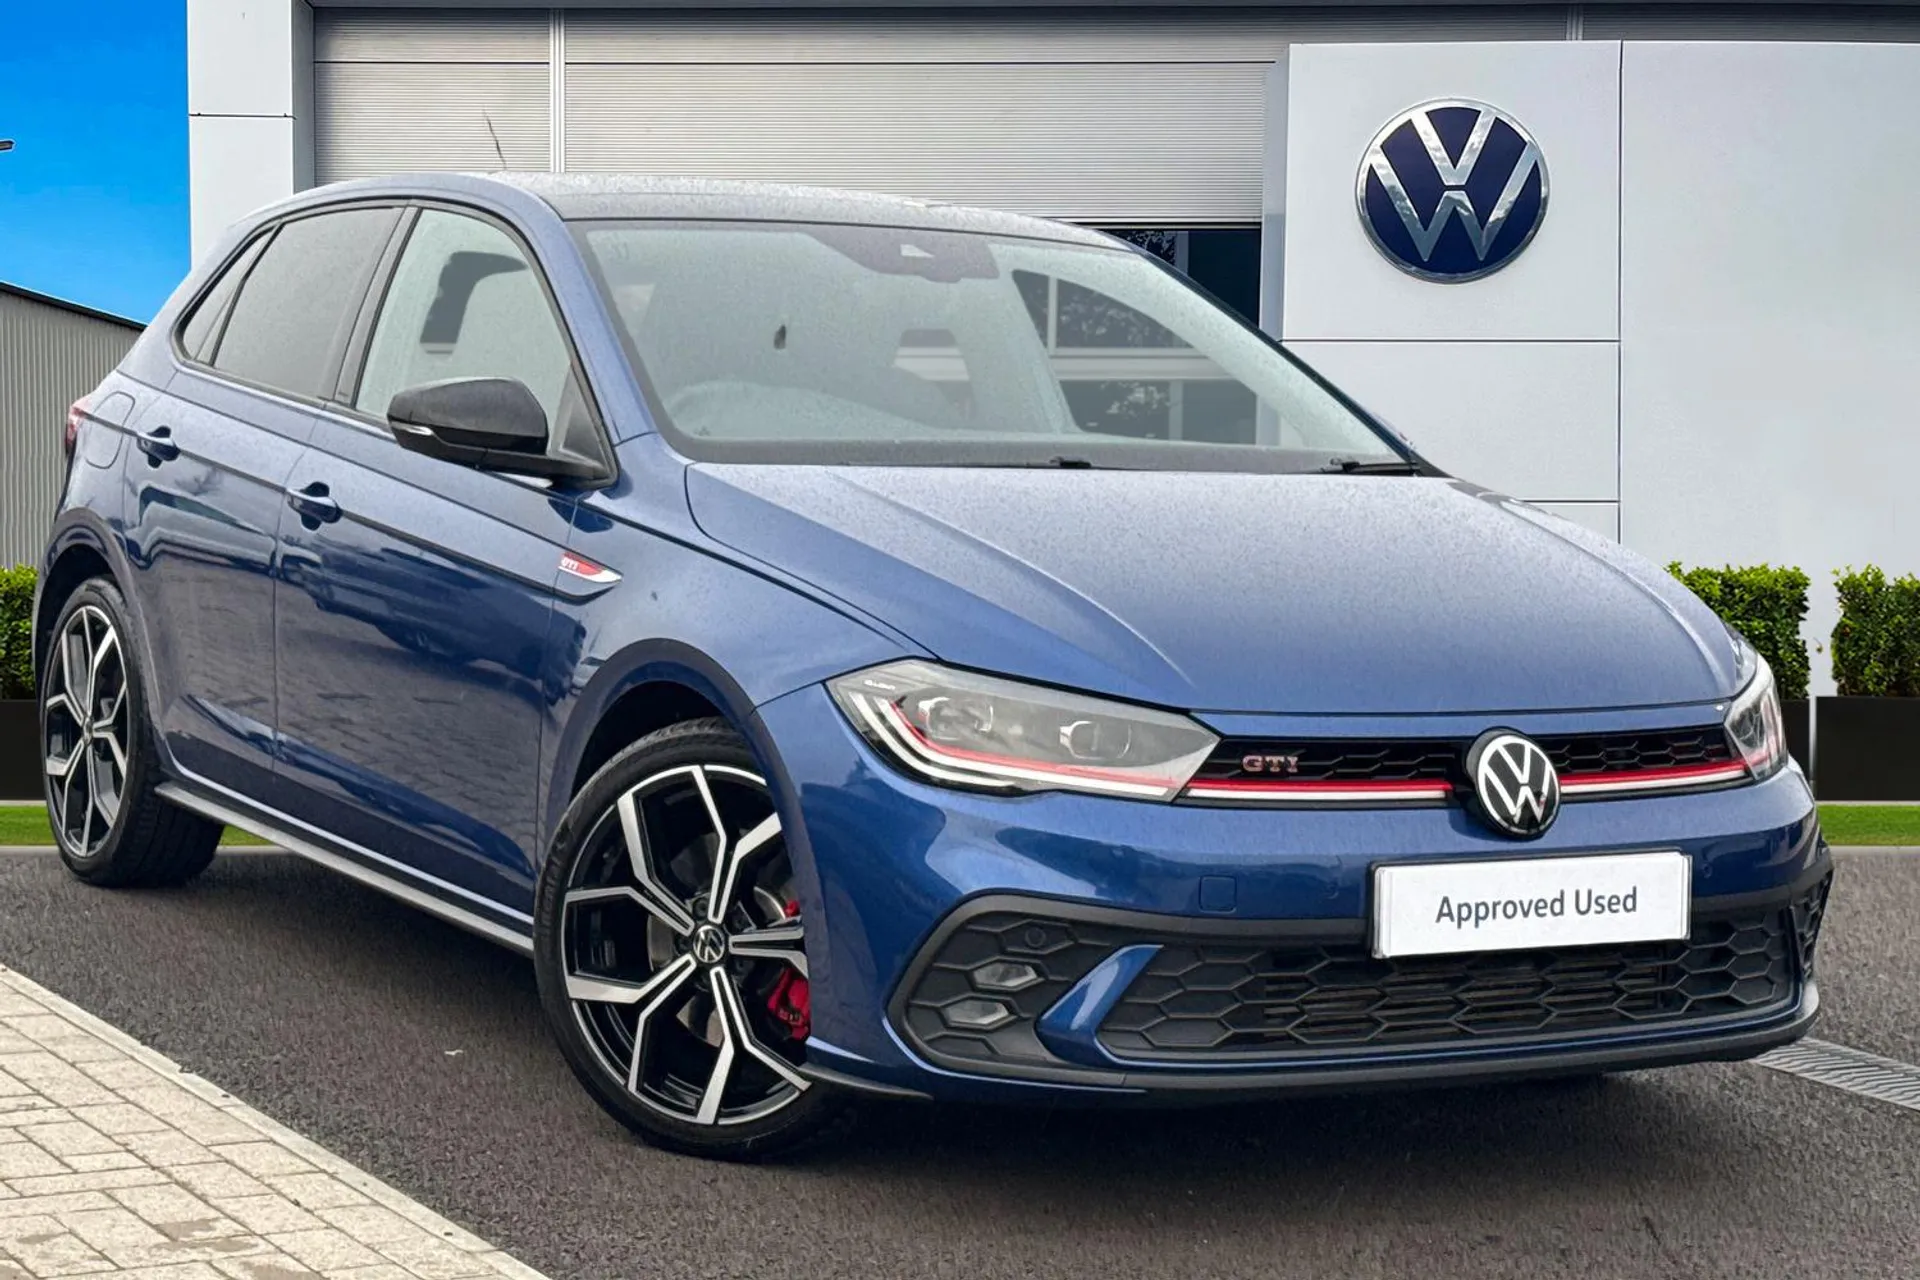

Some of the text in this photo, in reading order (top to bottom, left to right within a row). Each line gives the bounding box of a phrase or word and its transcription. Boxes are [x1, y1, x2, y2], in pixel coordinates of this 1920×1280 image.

[1242, 755, 1299, 773] GTI
[1435, 885, 1637, 930] Approved Used
